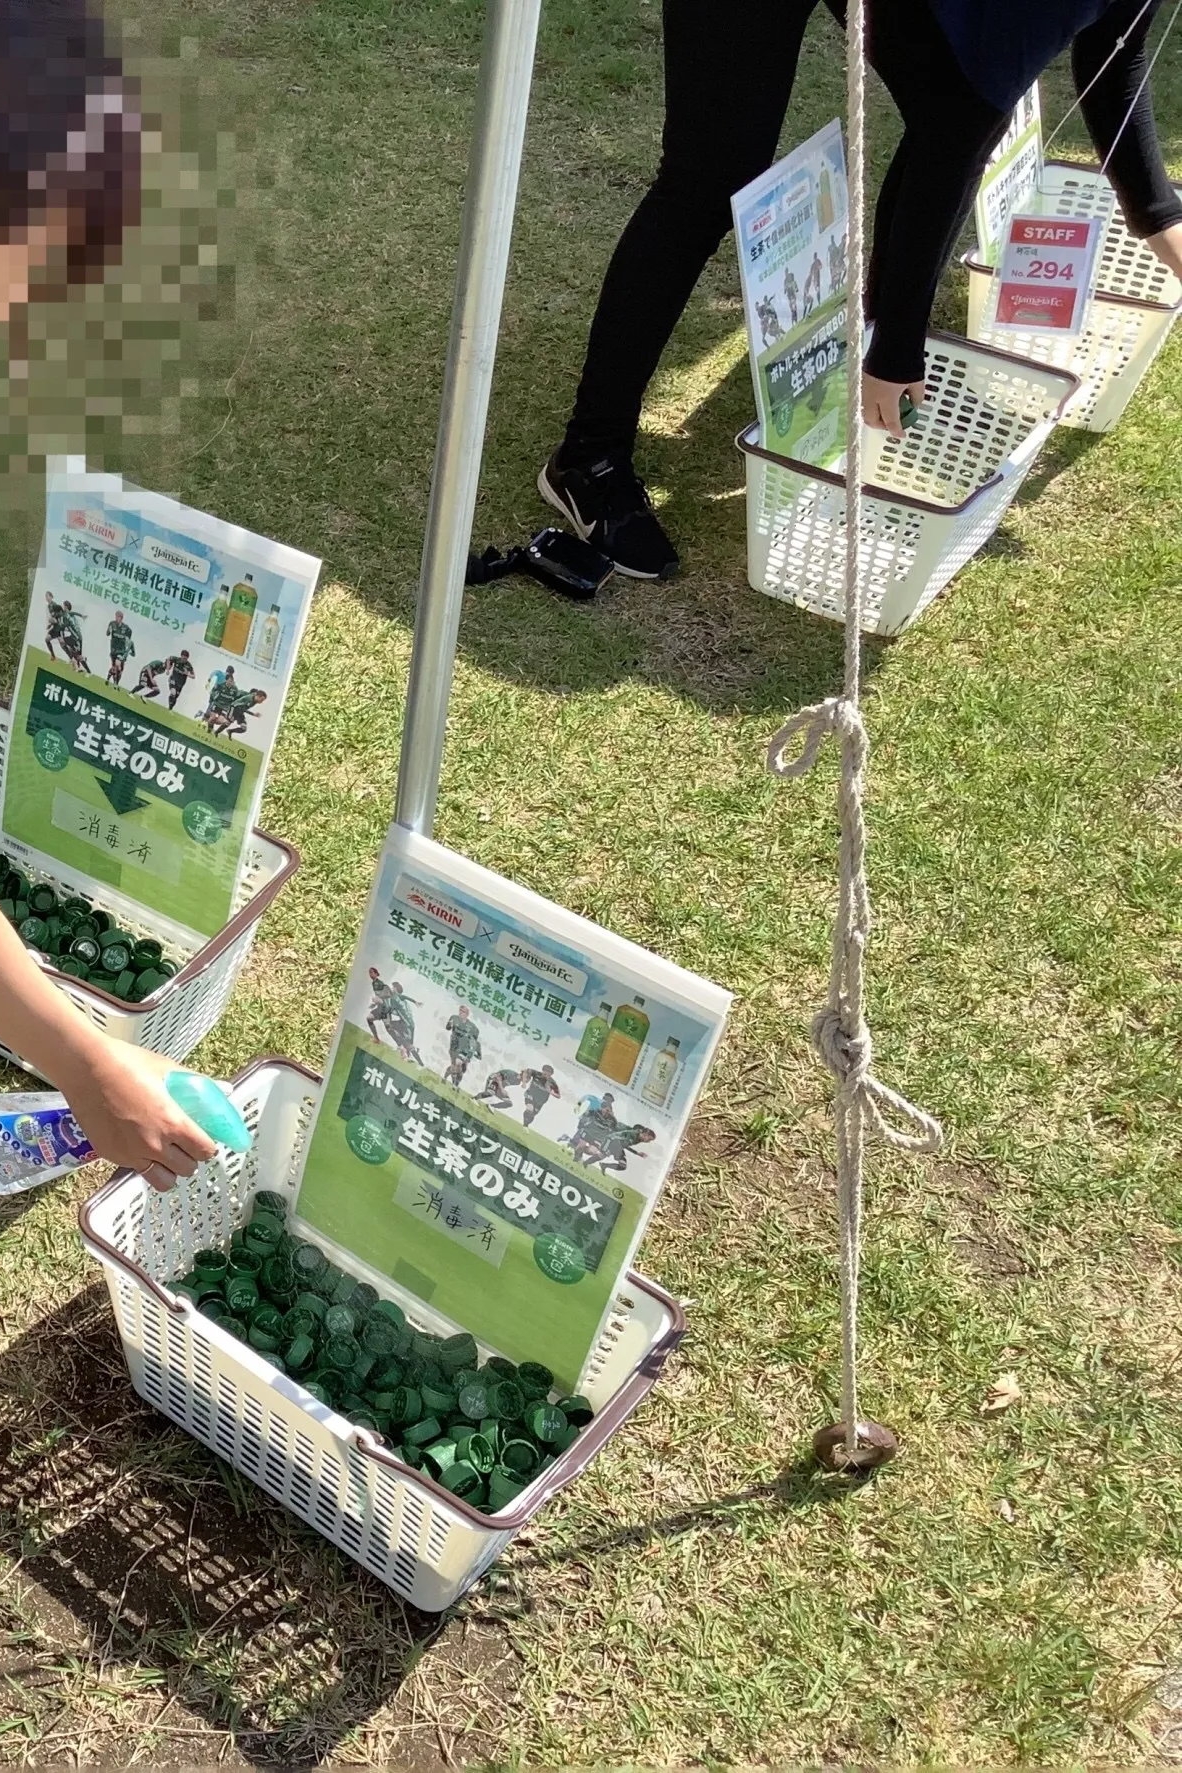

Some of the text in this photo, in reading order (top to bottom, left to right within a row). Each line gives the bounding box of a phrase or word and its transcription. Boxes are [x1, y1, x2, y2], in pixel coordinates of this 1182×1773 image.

[1023, 226, 1076, 241] STAFF
[1026, 260, 1074, 281] 294
[790, 340, 840, 398] 生茶のみ
[87, 521, 117, 541] KIRIN
[82, 565, 171, 612] キリン生茶を飲んで
[43, 682, 233, 784] ボトルキャップ回収BOX
[73, 721, 186, 794] 生茶のみ
[78, 810, 153, 864] 消毒済
[426, 902, 463, 928] KIRIN
[387, 909, 578, 1023] 生茶で信州緑化計画!
[418, 949, 532, 1019] キリン生茶を飲んで
[362, 1064, 604, 1223] ボトルキャップ回収BOX
[398, 1116, 541, 1220] 生茶のみ
[412, 1183, 498, 1251] 消毒済
